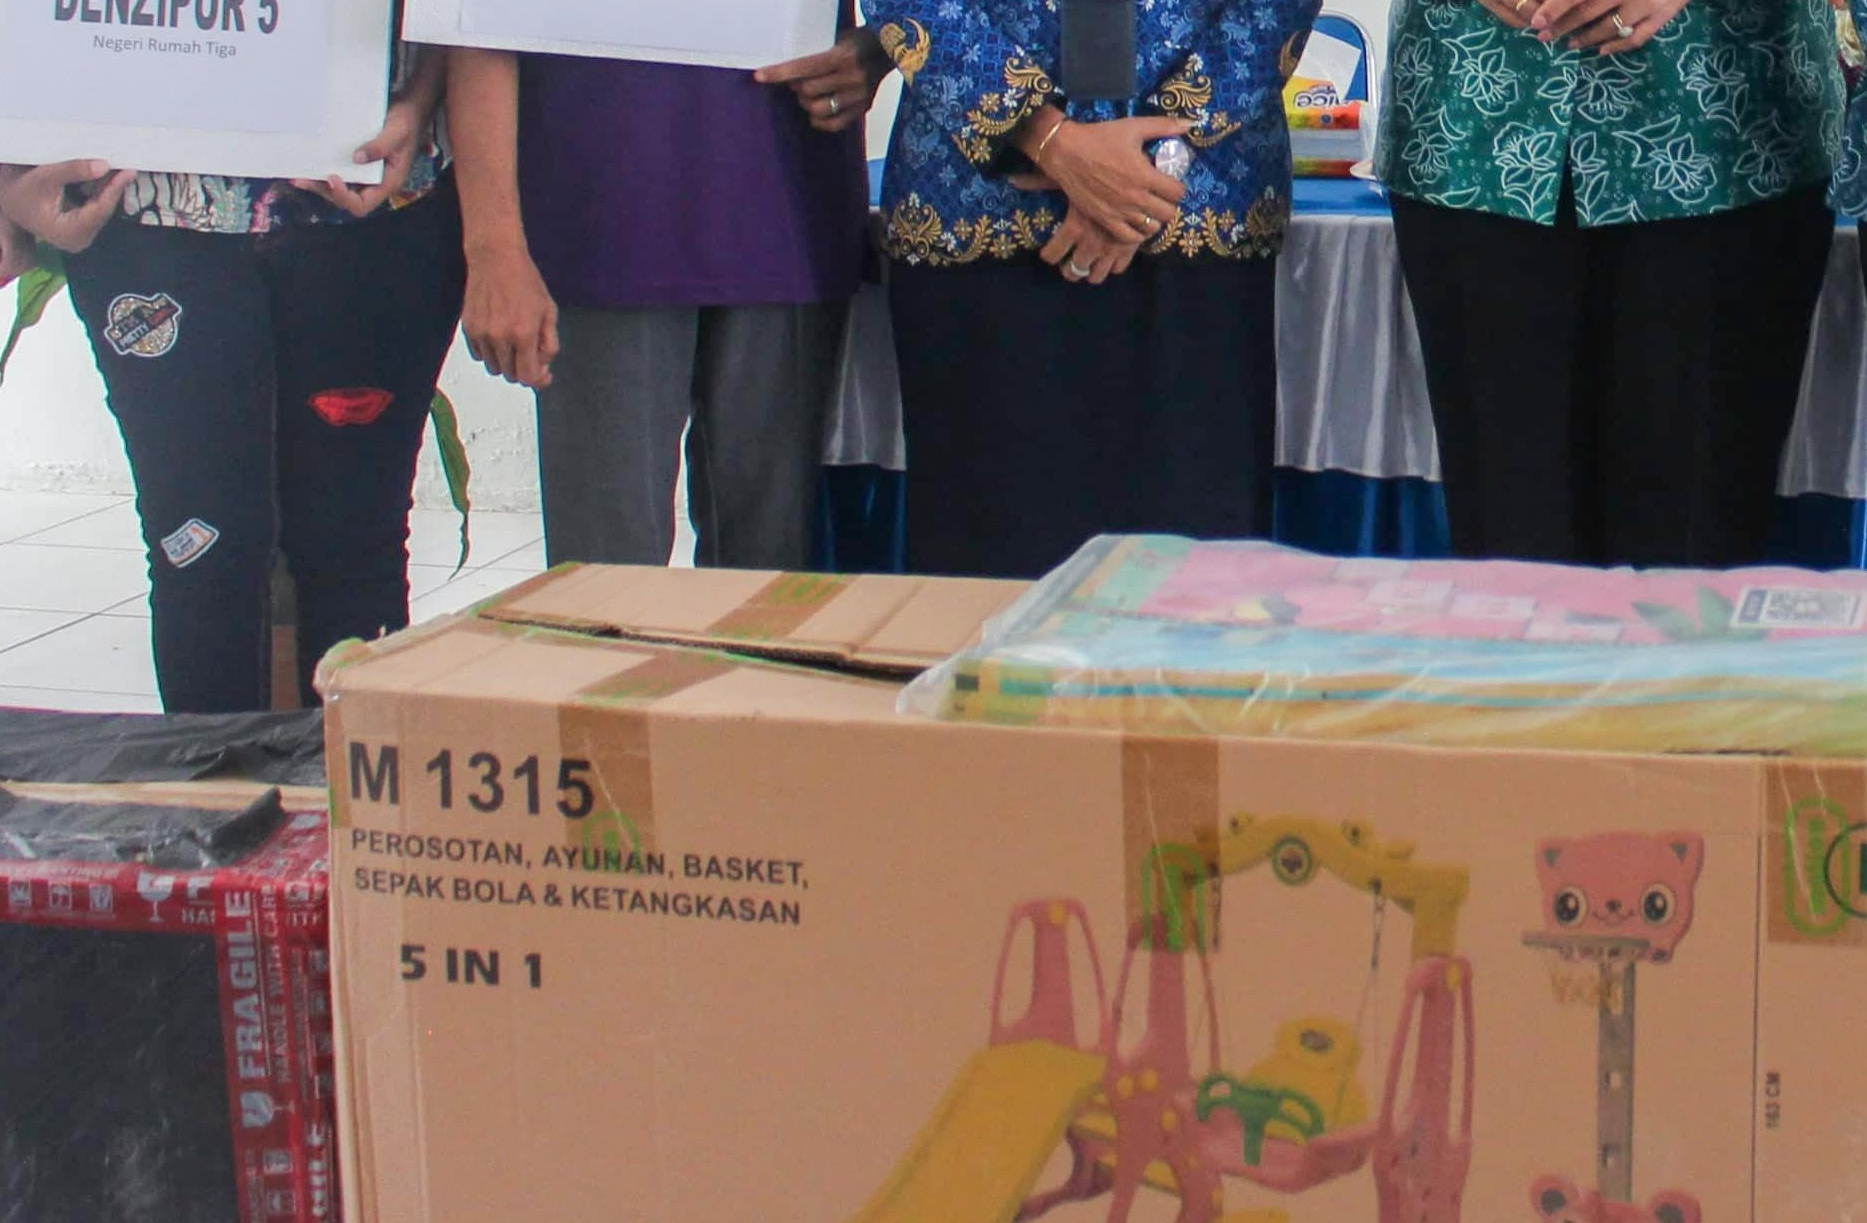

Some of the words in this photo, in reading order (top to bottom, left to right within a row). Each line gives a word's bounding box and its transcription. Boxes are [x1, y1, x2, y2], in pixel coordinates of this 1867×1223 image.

[93, 34, 144, 53] Negeri
[147, 37, 201, 54] Rumah
[205, 41, 237, 58] Tiga
[347, 741, 400, 807] M
[425, 747, 595, 820] 1315
[351, 827, 532, 870] PEROSOTAN,
[542, 846, 675, 881] AYUNAN,
[683, 854, 811, 890] BASKET,
[354, 866, 445, 900] SEPAK
[453, 875, 536, 907] BOLA
[543, 882, 564, 909] &
[571, 884, 801, 926] KETANGKASAN
[224, 889, 266, 1079] FRAGILE
[399, 944, 426, 981] 5
[446, 948, 500, 986] IN
[524, 953, 543, 988] 1
[267, 1005, 292, 1083] HANDLE
